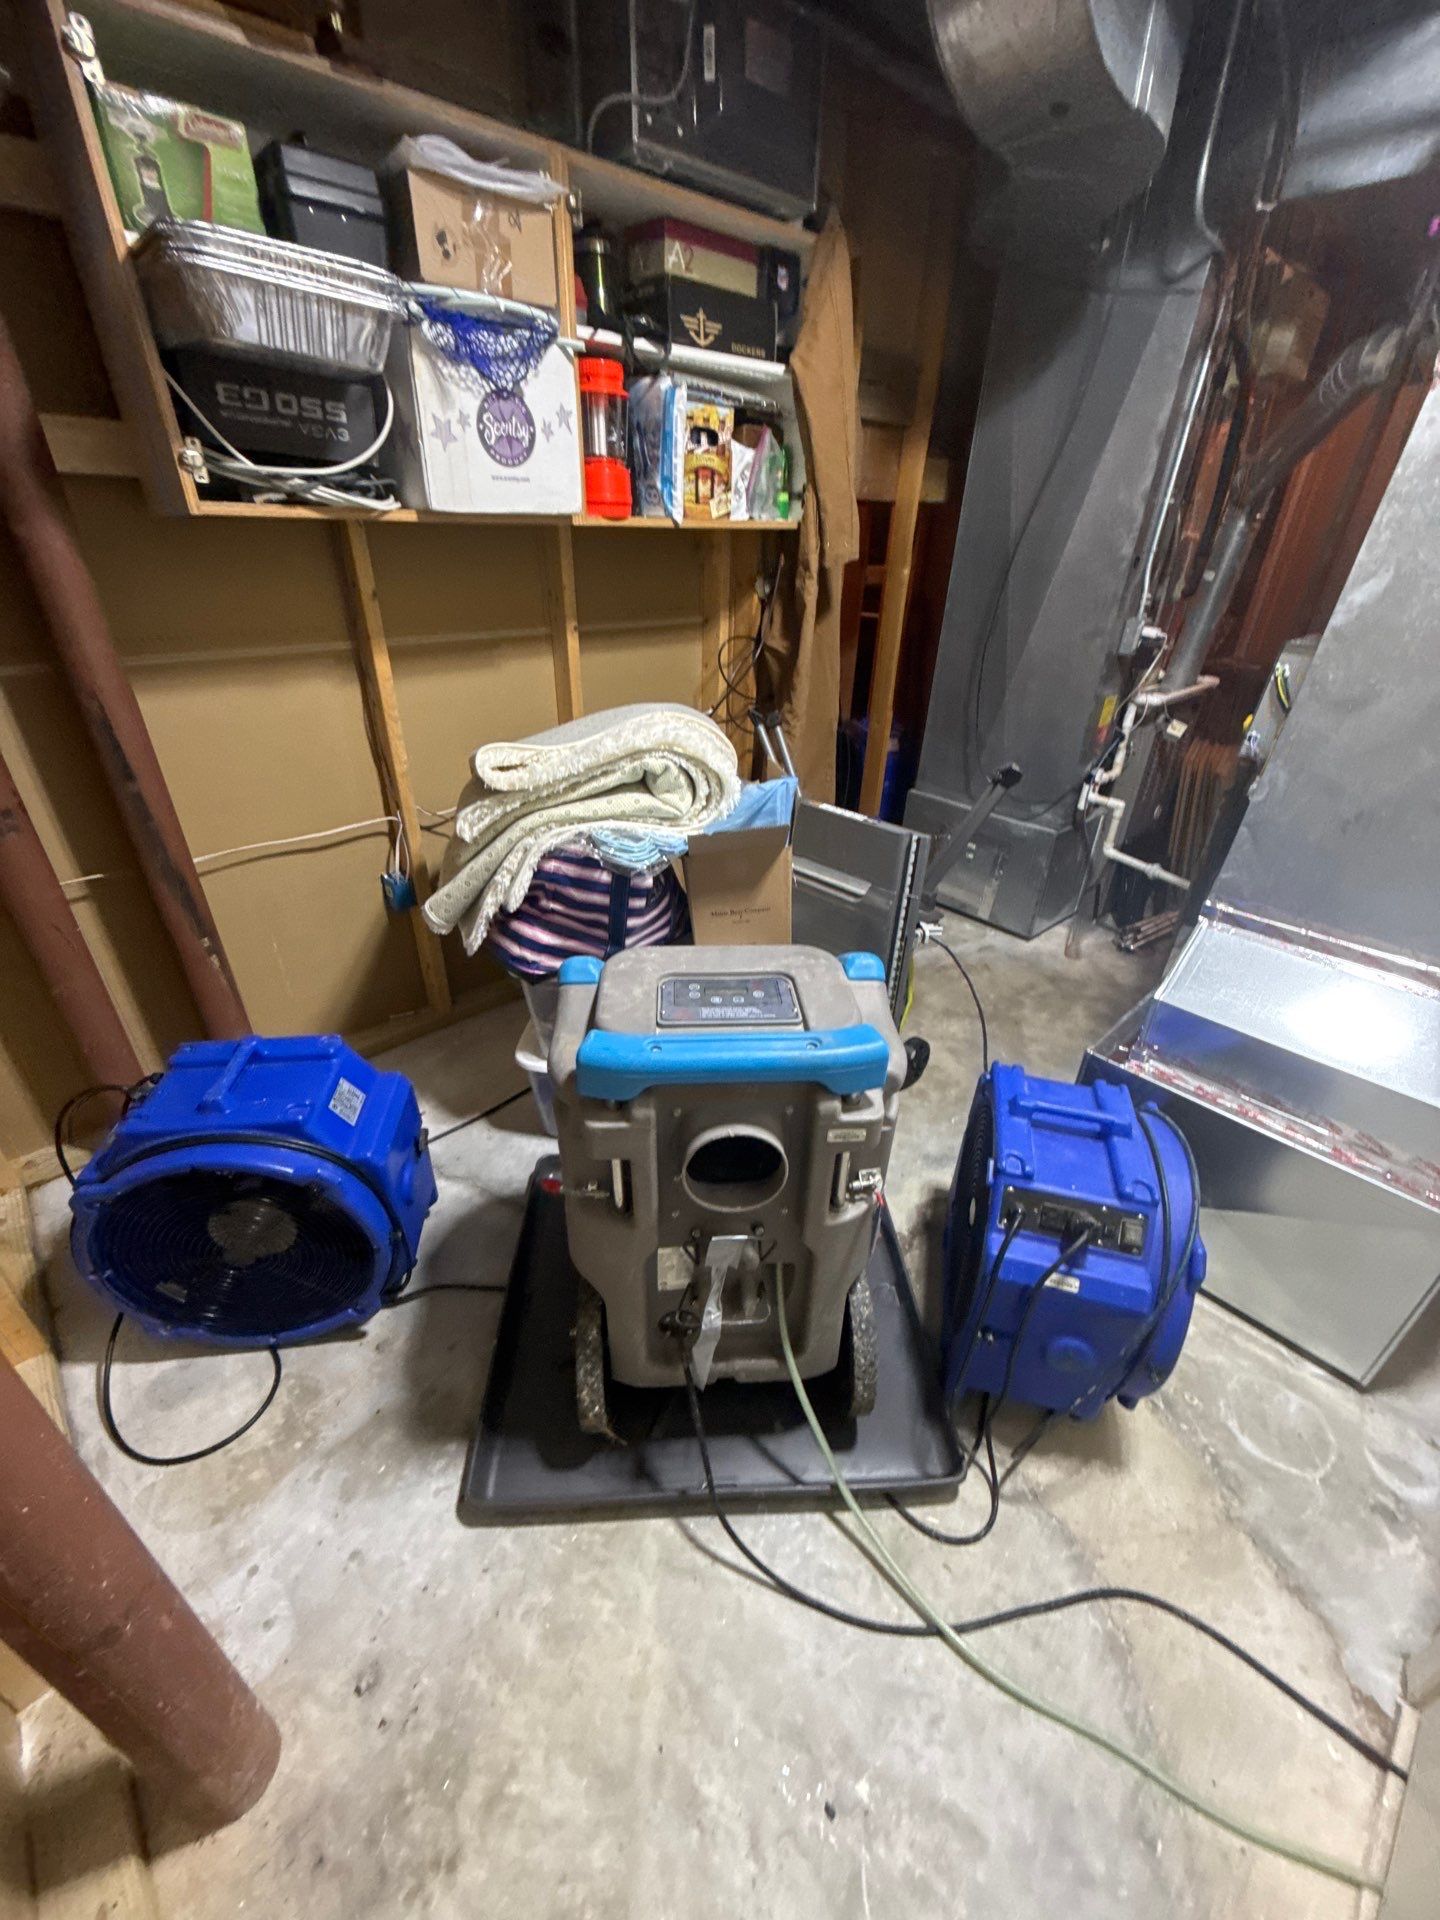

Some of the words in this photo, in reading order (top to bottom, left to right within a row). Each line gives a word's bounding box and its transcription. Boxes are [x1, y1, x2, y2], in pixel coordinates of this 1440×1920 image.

[731, 341, 766, 359] DOCKERS
[215, 382, 269, 411] G3
[274, 392, 348, 424] 550
[482, 411, 530, 448] Scentsy
